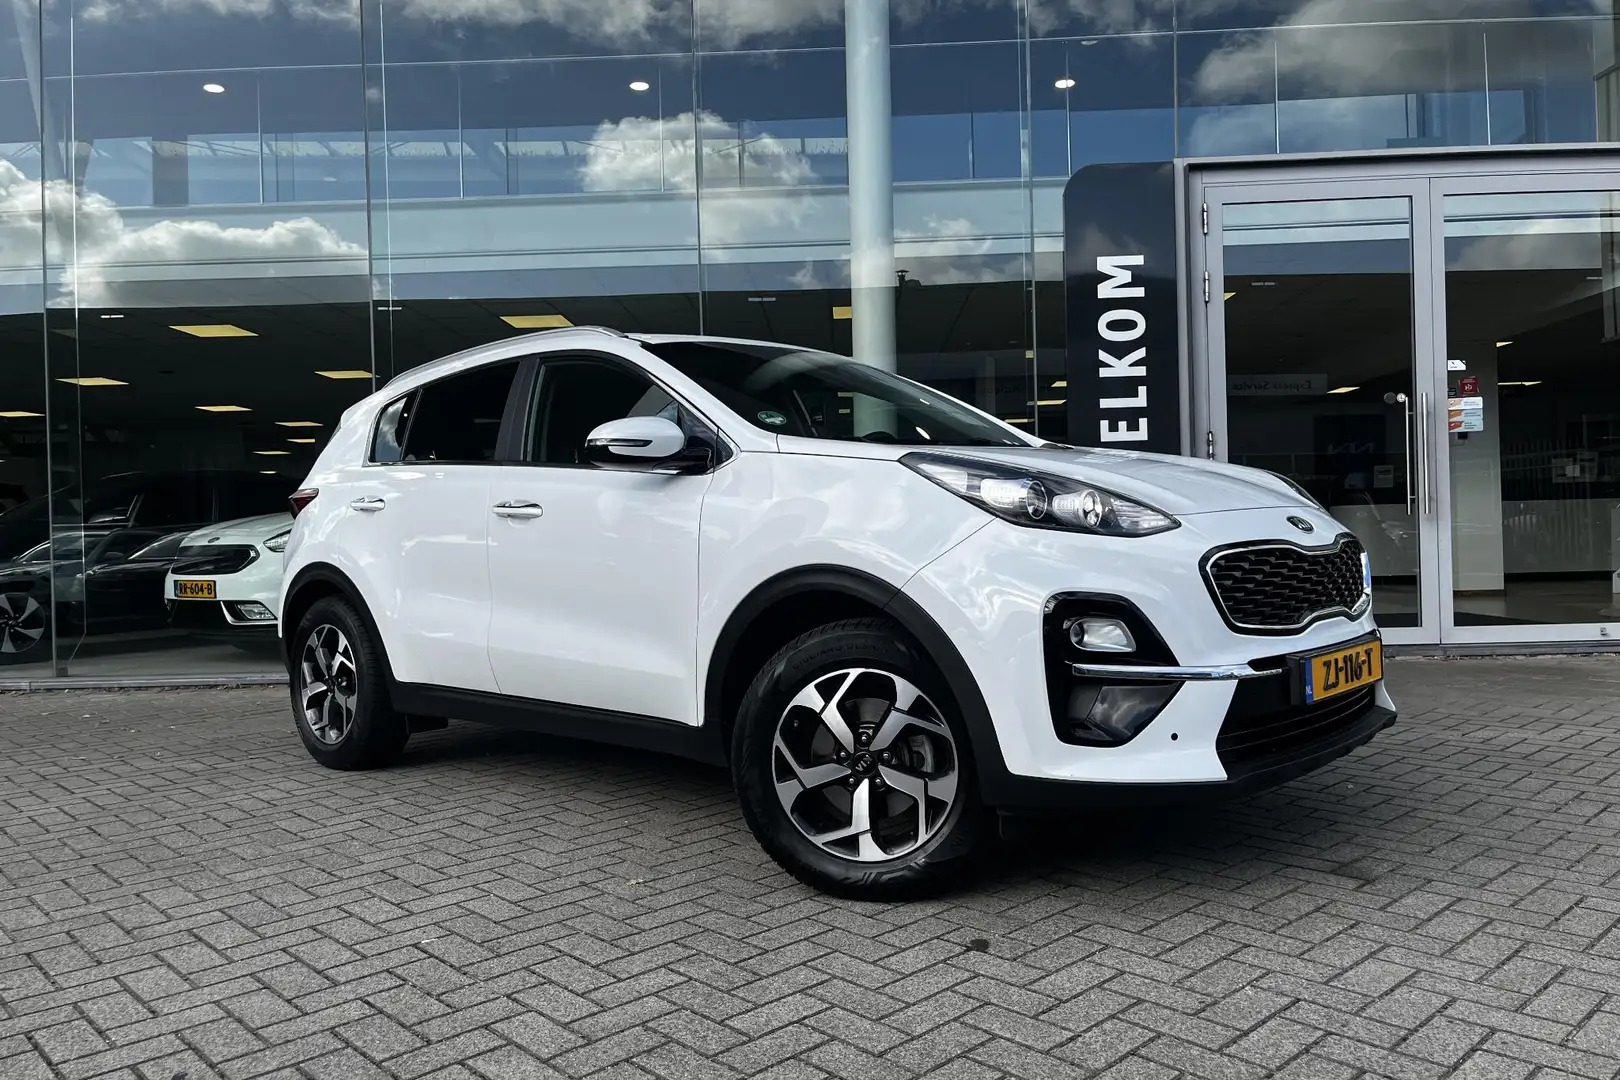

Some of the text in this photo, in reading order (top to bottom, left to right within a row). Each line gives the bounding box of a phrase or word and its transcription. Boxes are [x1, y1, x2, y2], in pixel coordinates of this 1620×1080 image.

[1097, 255, 1148, 442] ELKOM
[179, 583, 213, 595] RR-604-B
[1323, 648, 1374, 691] ZJ-116-T
